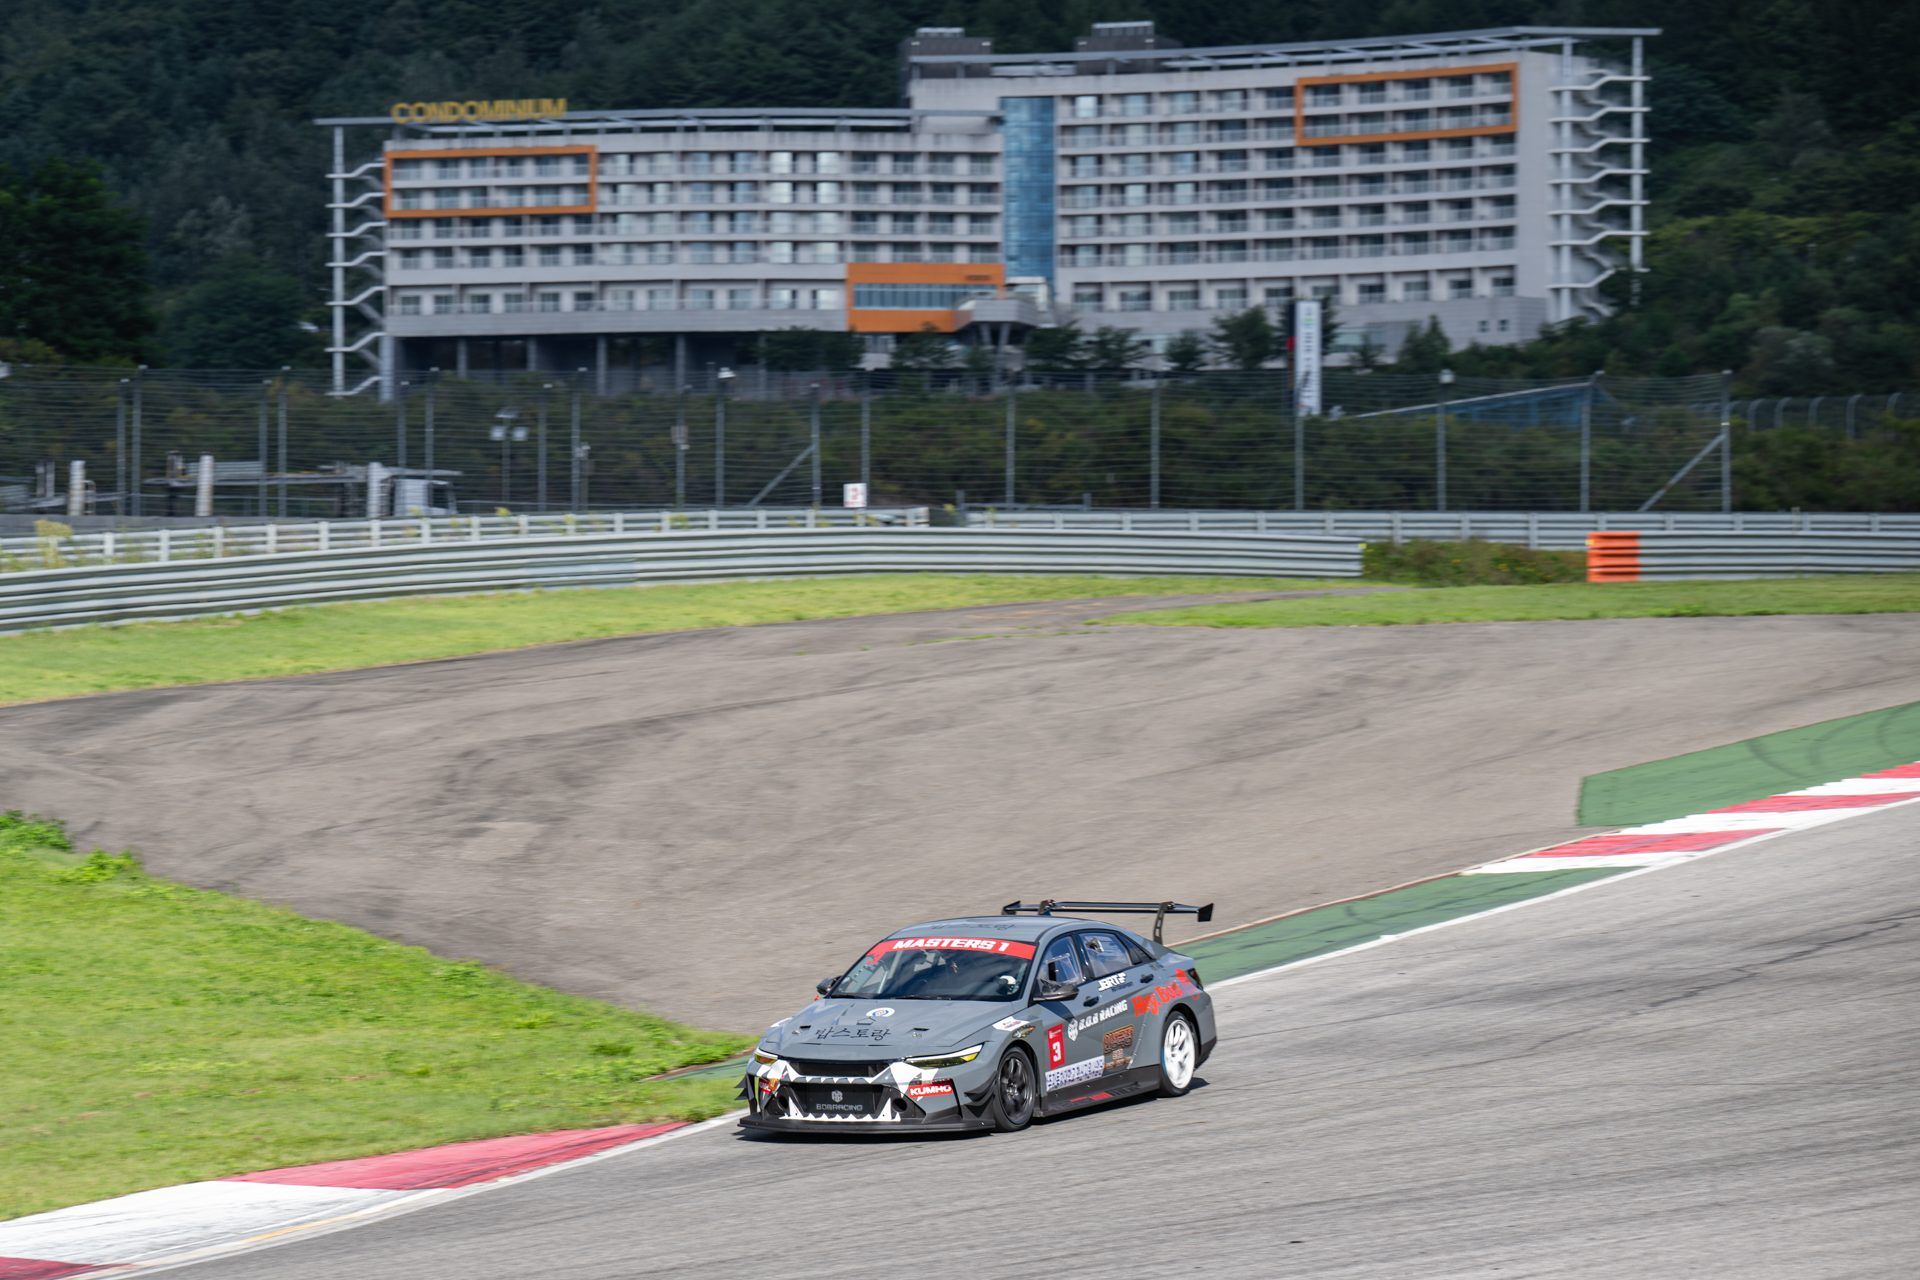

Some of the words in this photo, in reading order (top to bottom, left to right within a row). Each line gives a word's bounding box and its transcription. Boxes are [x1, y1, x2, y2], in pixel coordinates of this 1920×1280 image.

[390, 98, 567, 124] CONDOMINIUM
[893, 938, 993, 950] MASTERS
[998, 942, 1010, 952] 1
[1099, 999, 1128, 1021] RACING
[815, 1026, 891, 1041] 밥스토랑
[1052, 1041, 1062, 1063] 3
[910, 1084, 952, 1096] KUMHO
